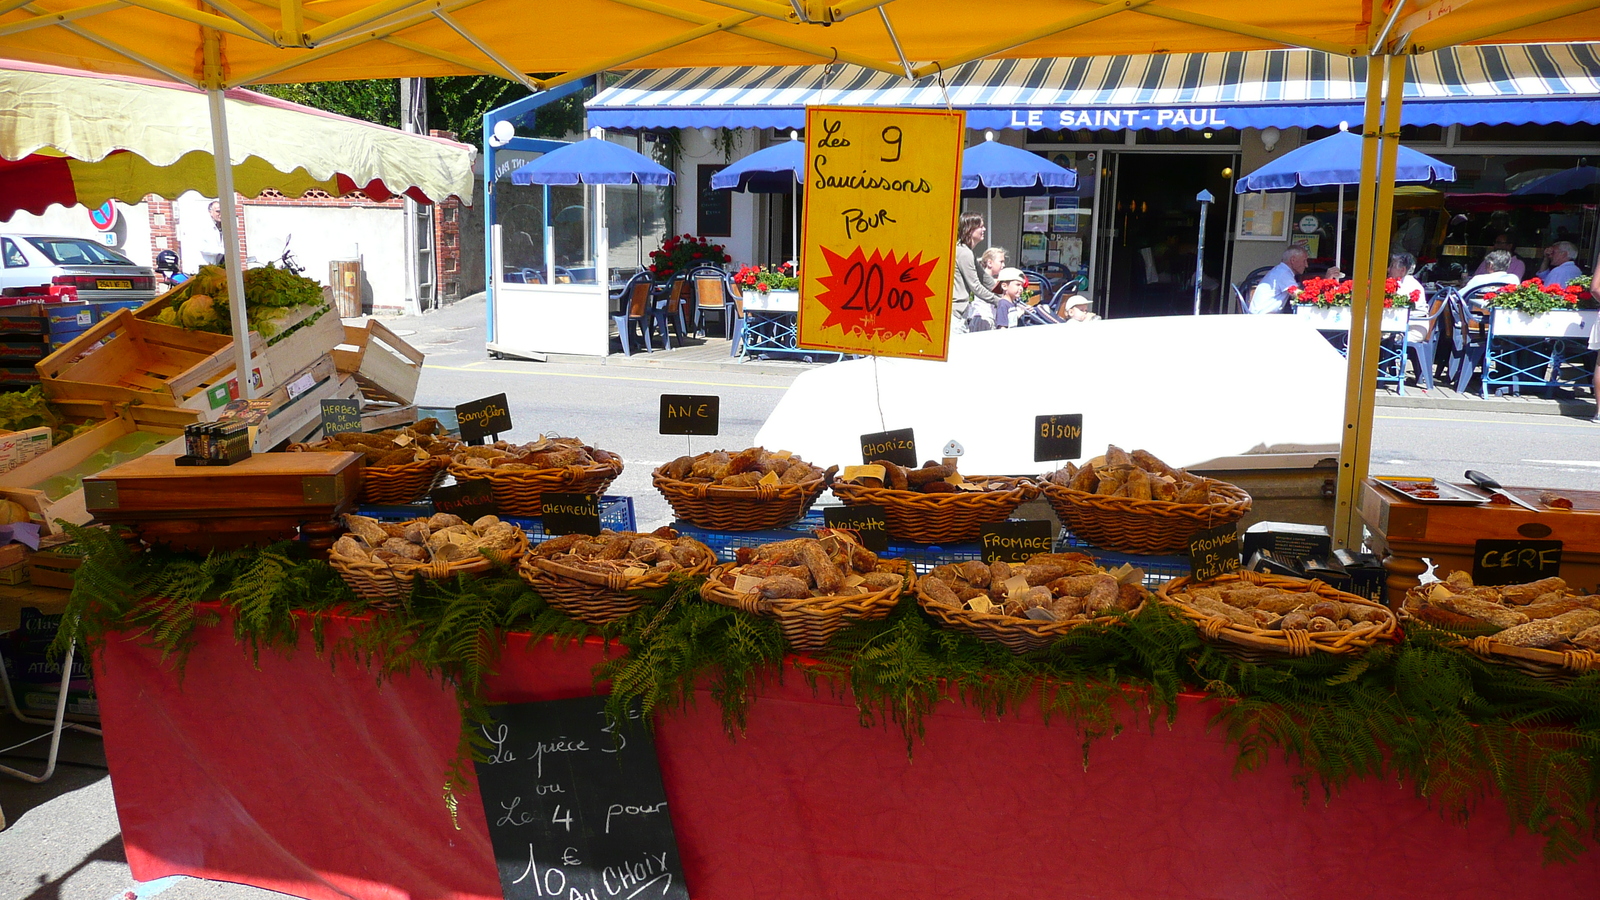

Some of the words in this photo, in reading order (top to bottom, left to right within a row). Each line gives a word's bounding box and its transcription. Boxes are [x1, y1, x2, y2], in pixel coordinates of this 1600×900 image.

[1010, 110, 1042, 126] LE
[1060, 108, 1225, 126] SAINT-PAUL
[818, 118, 851, 148] Les
[881, 126, 902, 162] 9
[814, 154, 931, 193] Saucissons
[322, 404, 357, 417] HERBES
[668, 403, 709, 418] ANE
[326, 420, 362, 433] PROVENCE
[983, 532, 1052, 550] FROMAGE
[1190, 530, 1238, 558] FROMAGE
[1205, 552, 1221, 564] DE
[1481, 548, 1561, 571] CERF
[25, 618, 59, 630] Clas
[27, 662, 90, 675] ATLATI
[481, 723, 517, 765] La
[536, 783, 565, 795] ou
[552, 804, 574, 832] 4
[605, 801, 668, 834] pour
